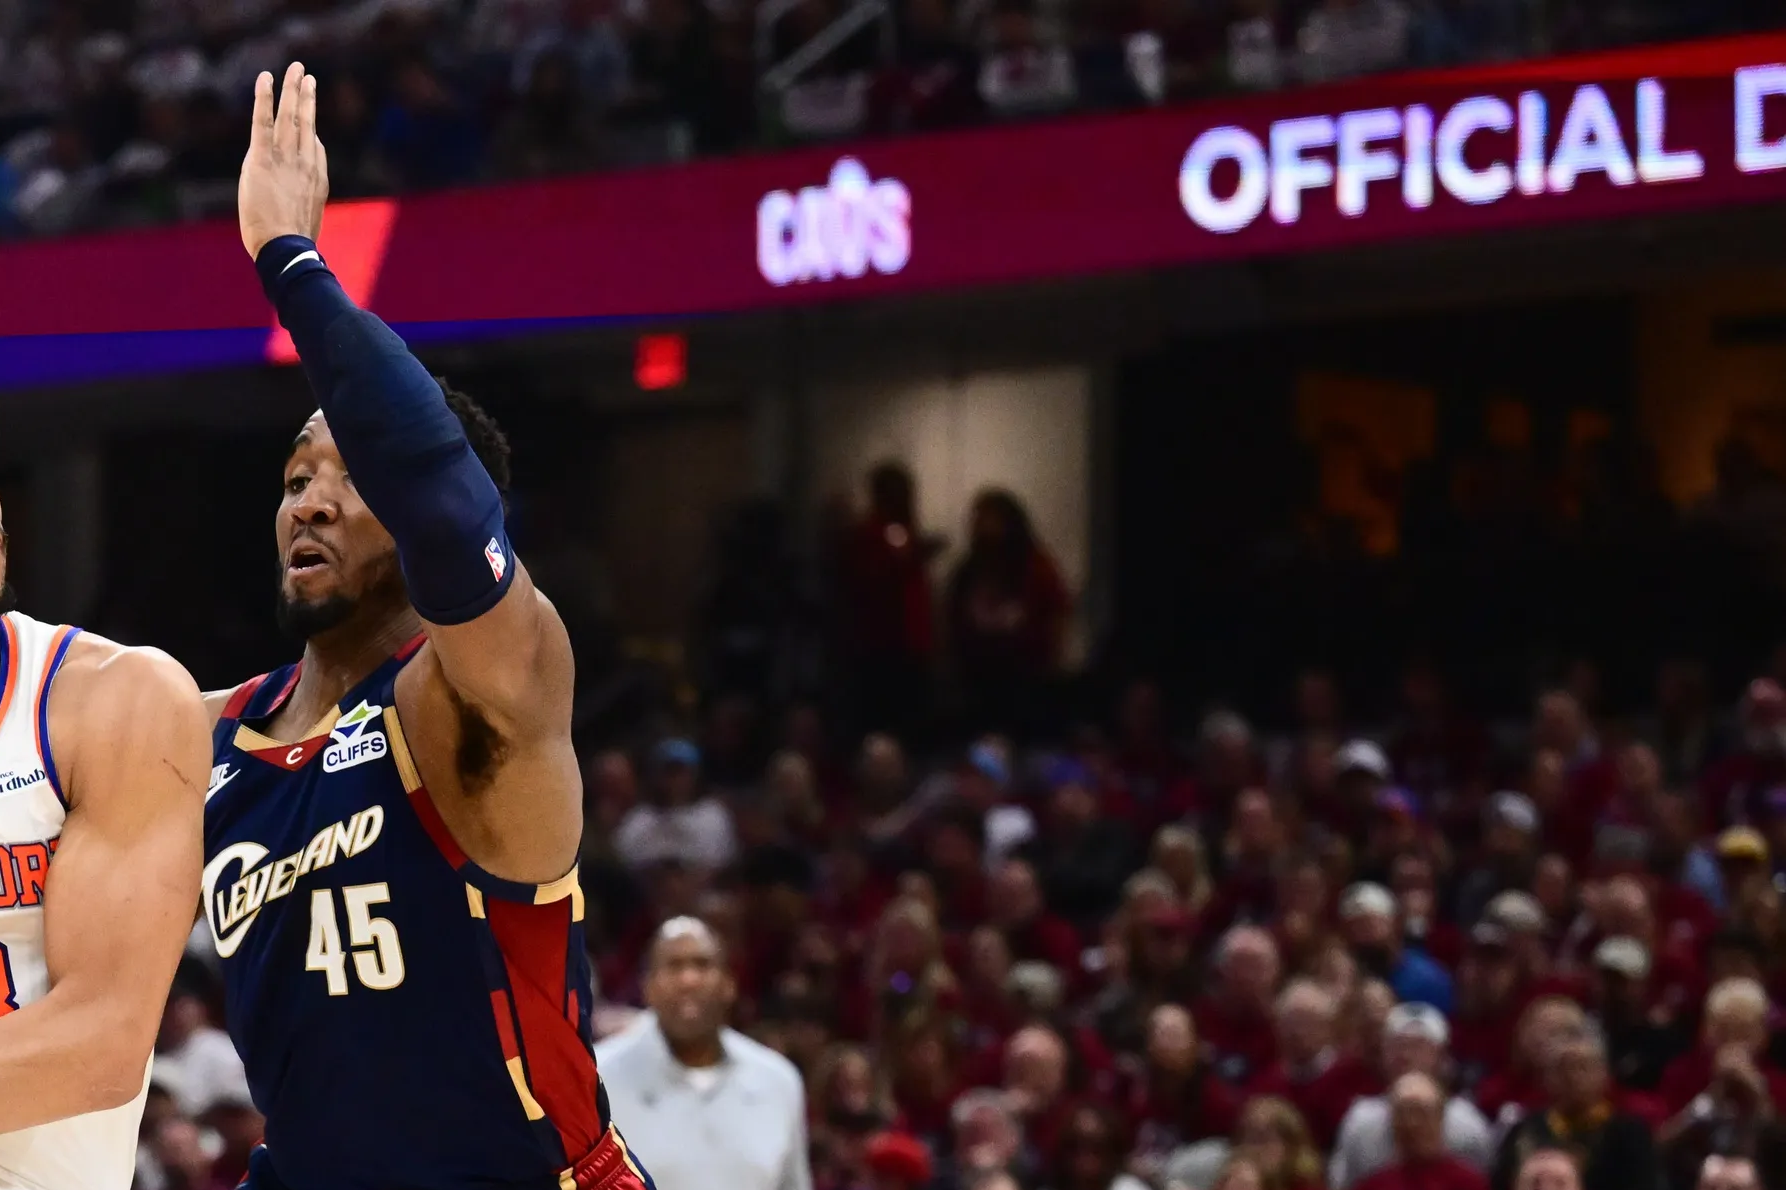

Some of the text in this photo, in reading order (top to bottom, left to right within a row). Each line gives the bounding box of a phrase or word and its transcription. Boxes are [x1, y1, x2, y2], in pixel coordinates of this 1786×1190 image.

[1180, 78, 1704, 233] OFFICIAL
[326, 736, 385, 767] CLIFFS
[305, 881, 405, 996] 45
